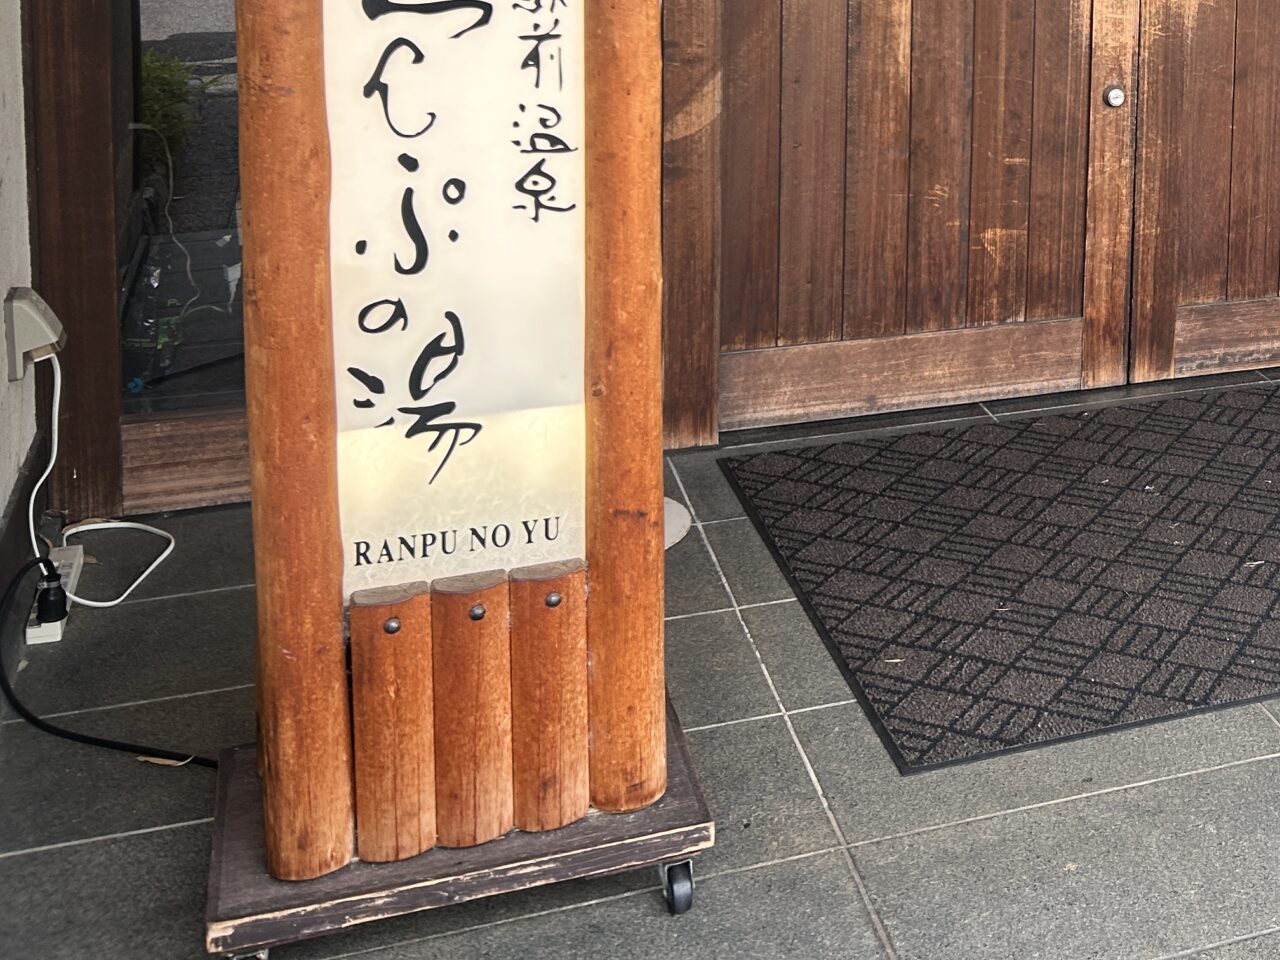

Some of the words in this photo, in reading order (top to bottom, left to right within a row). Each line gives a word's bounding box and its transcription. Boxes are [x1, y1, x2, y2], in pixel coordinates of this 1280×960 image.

[353, 529, 458, 567] RANPU
[468, 523, 512, 552] NO
[521, 516, 561, 545] YU
